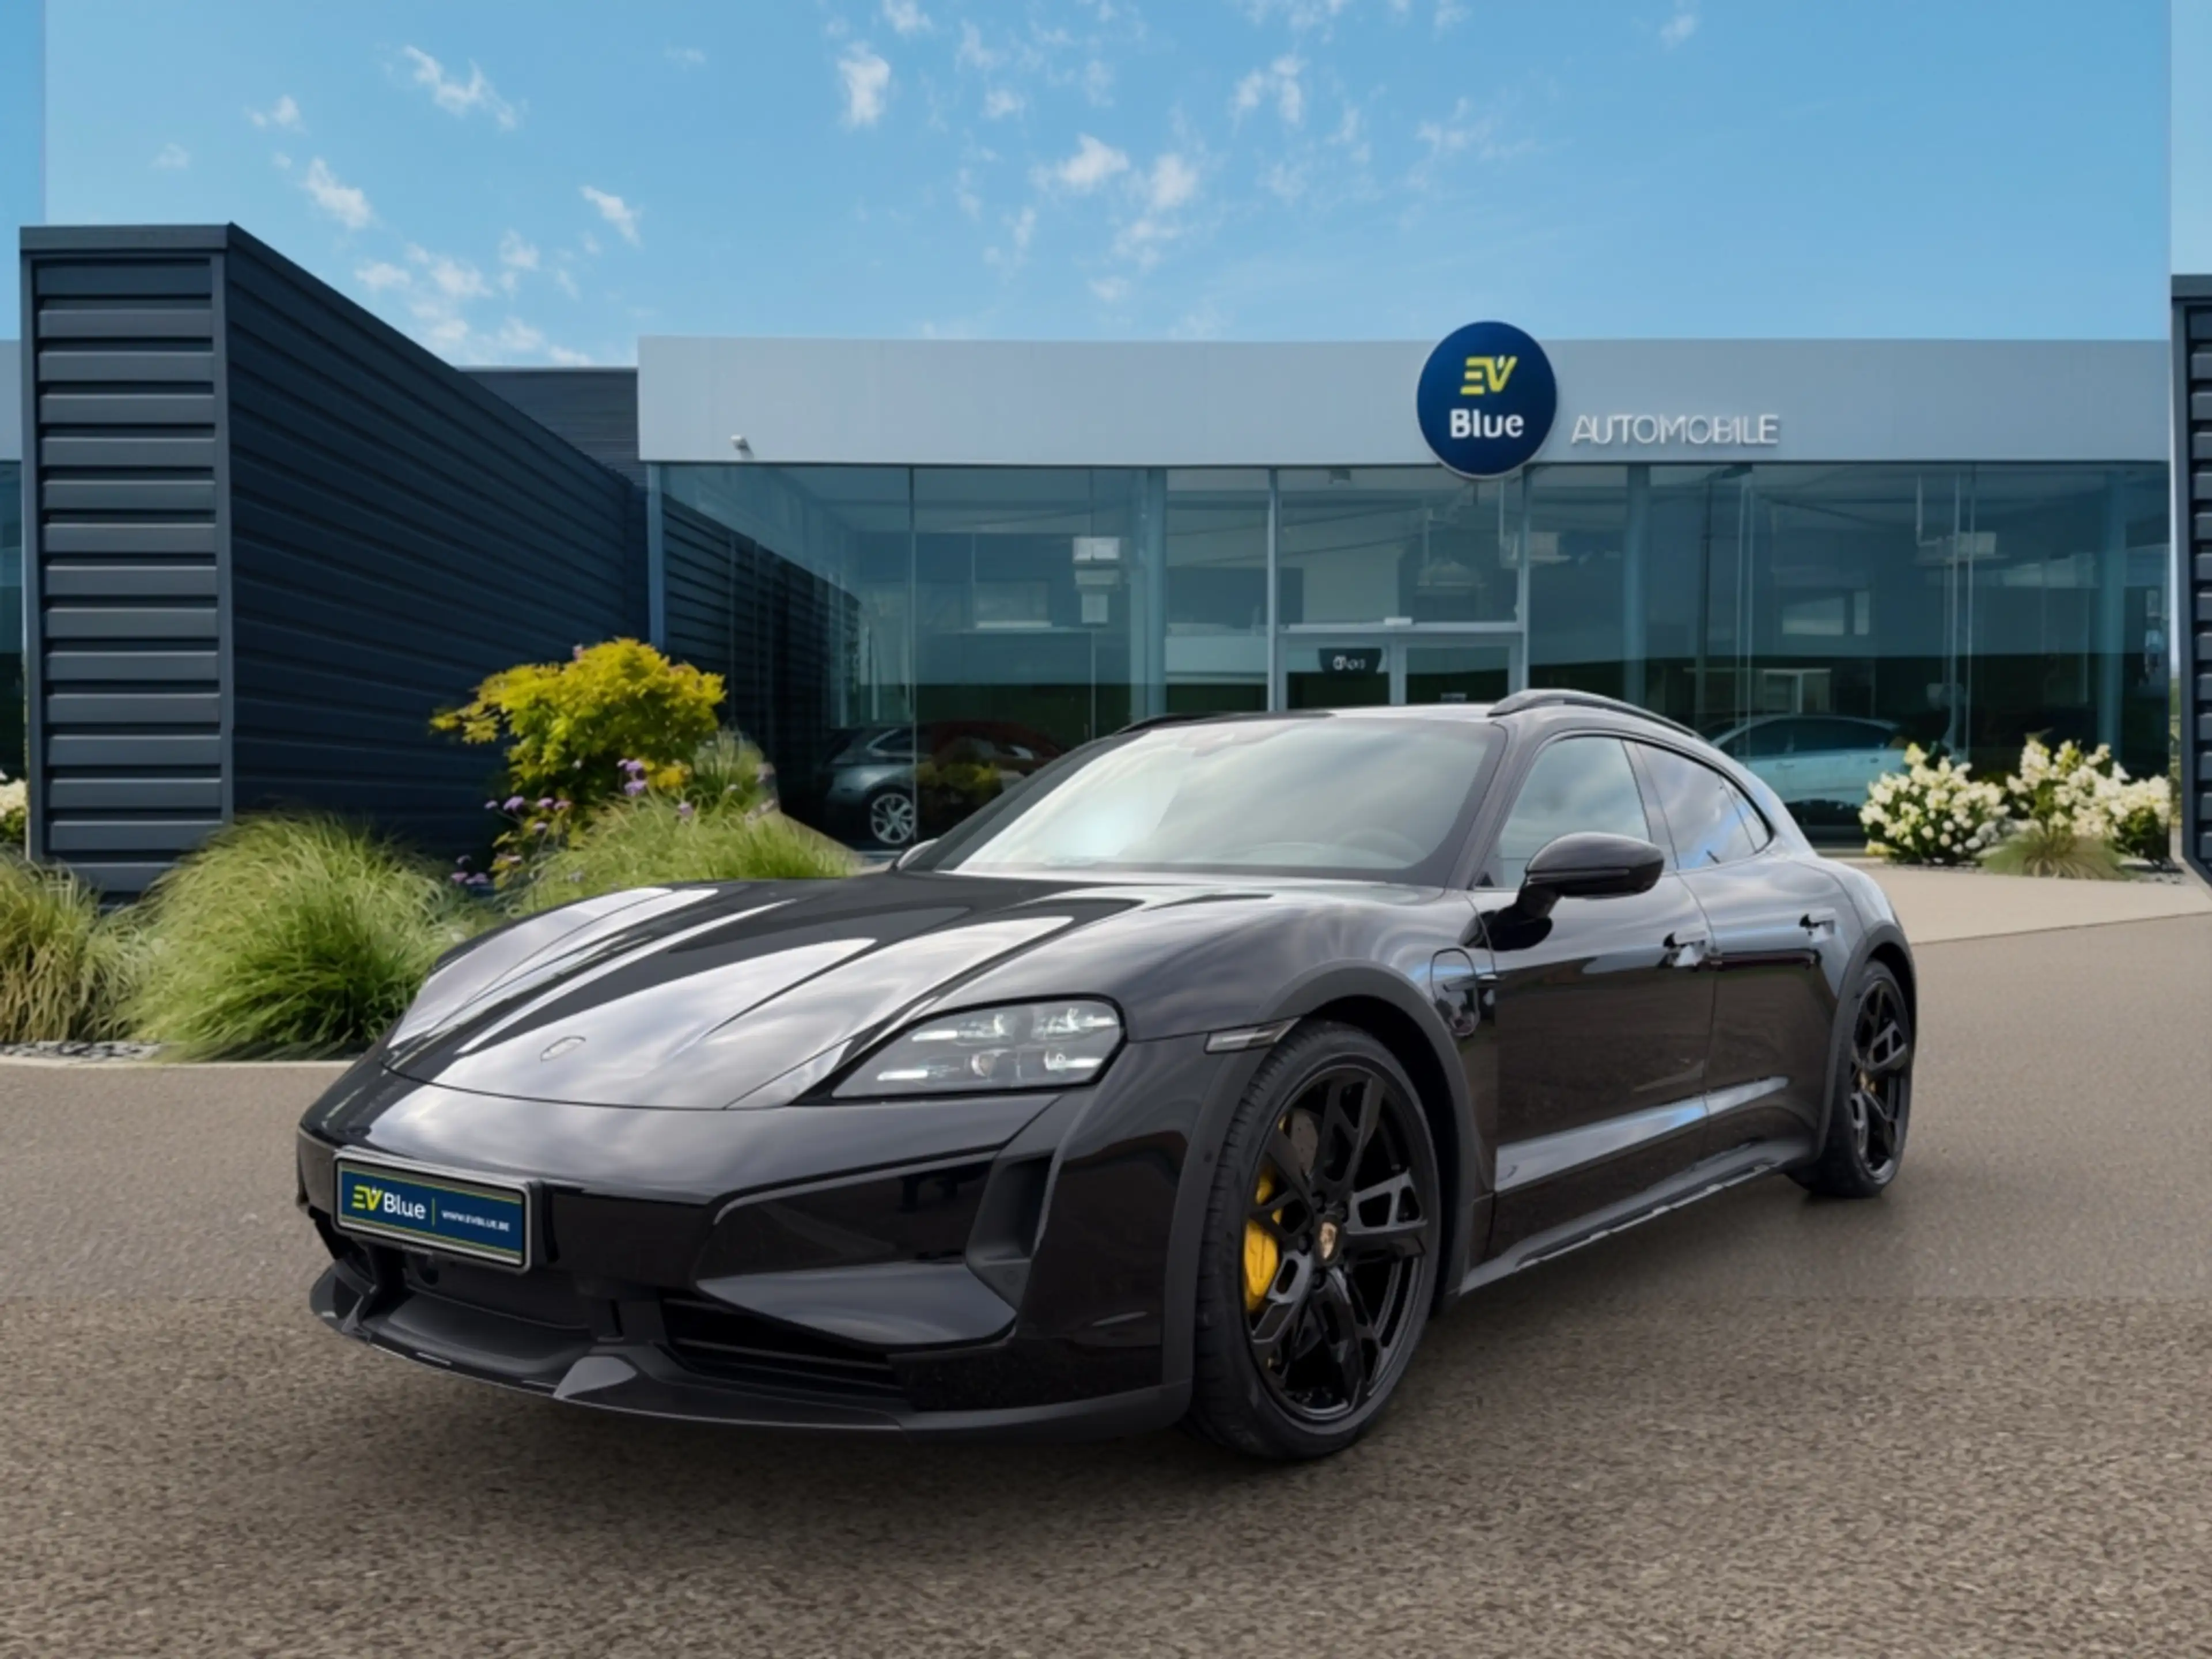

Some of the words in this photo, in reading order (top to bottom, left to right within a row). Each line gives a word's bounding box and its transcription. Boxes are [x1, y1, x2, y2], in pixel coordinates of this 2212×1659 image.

[1460, 355, 1518, 395] EV
[1450, 408, 1525, 438] Blue
[1570, 414, 1779, 445] AUTOMOBILE
